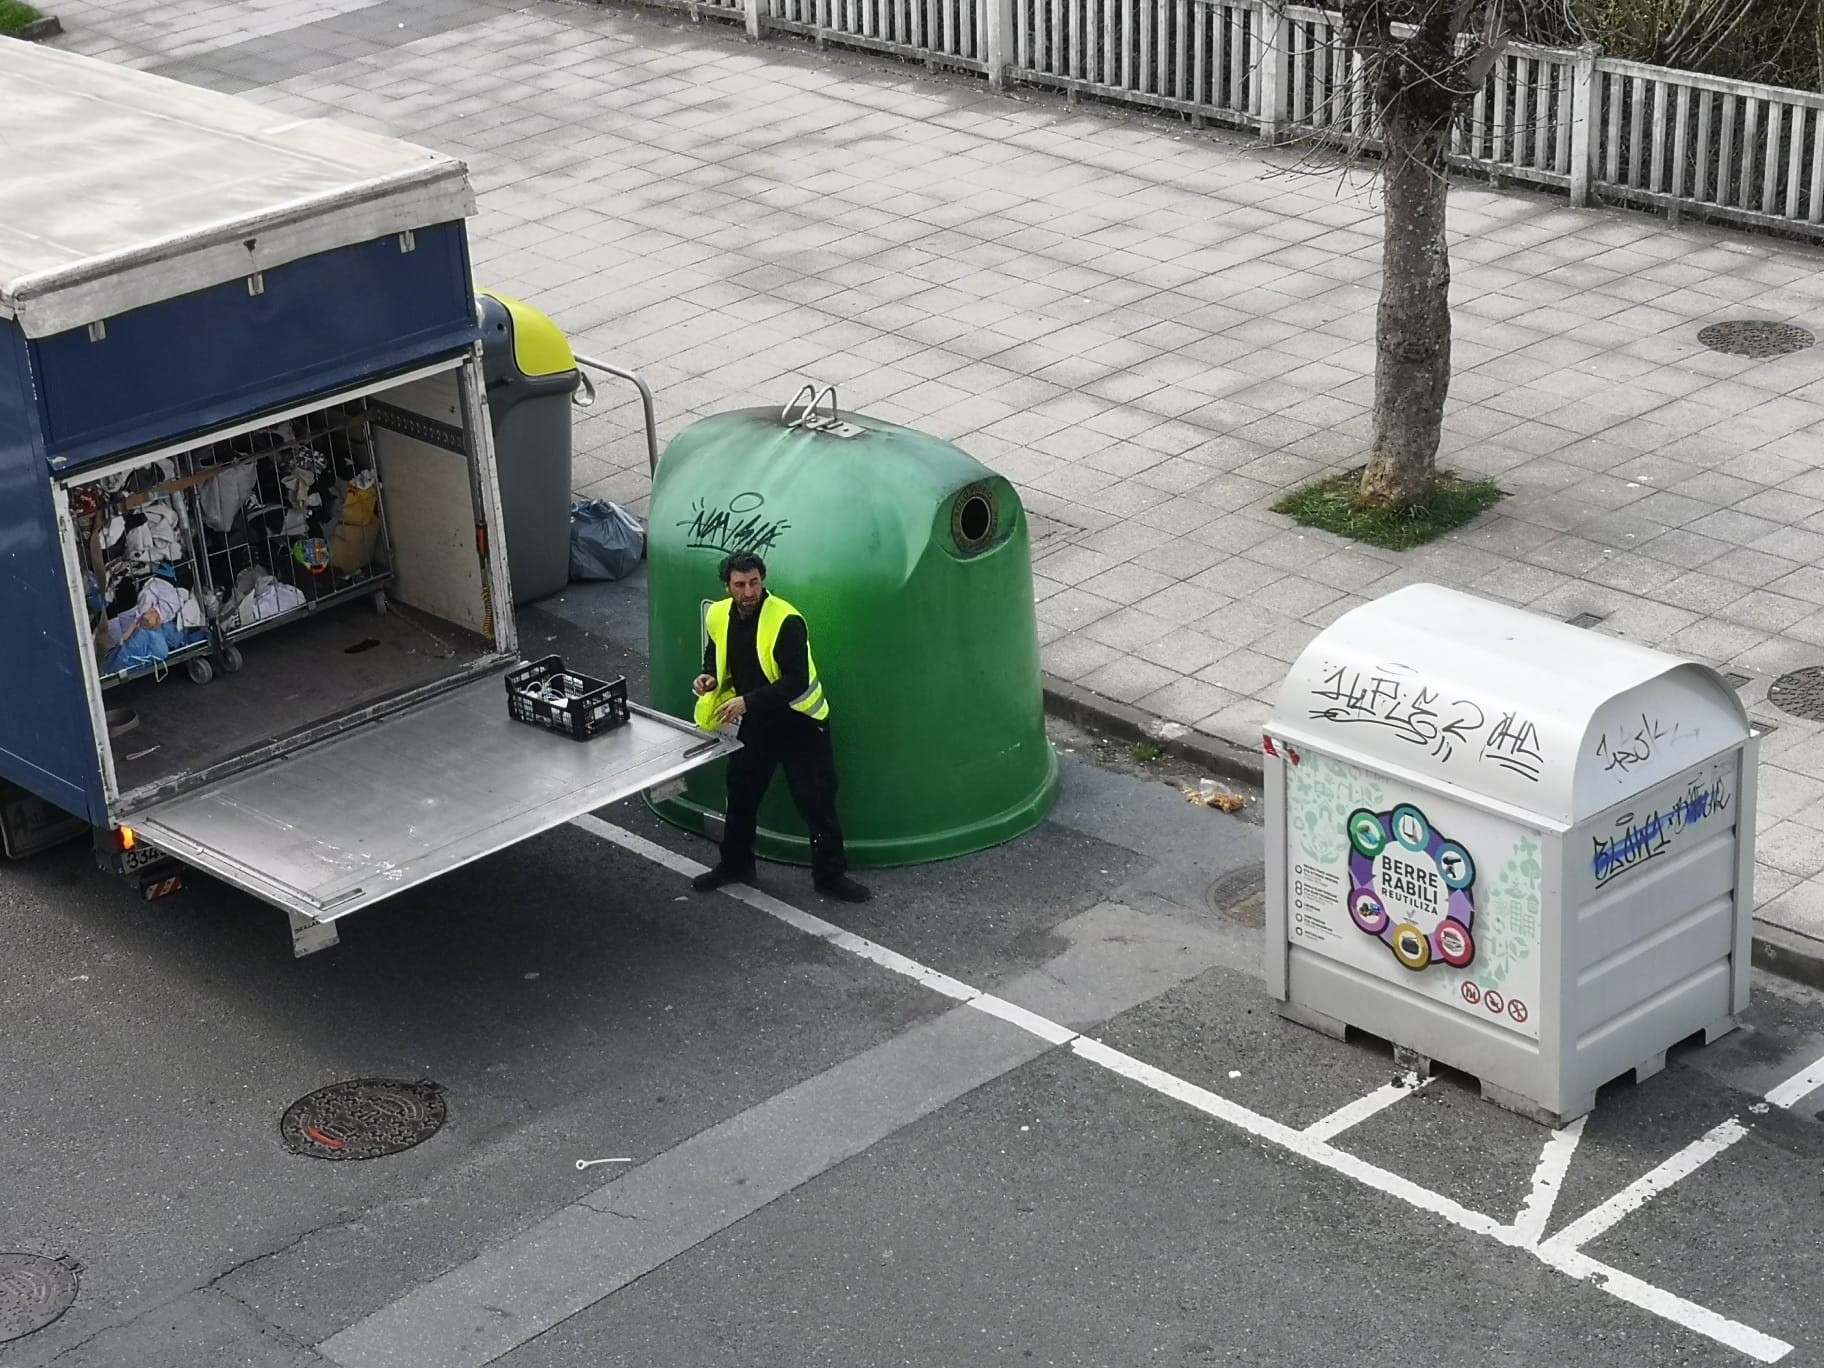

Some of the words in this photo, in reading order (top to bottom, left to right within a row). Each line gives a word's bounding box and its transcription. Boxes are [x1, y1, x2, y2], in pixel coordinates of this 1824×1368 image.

[1381, 855, 1438, 889] BERRE
[1381, 871, 1438, 905] RABILI
[1381, 886, 1439, 916] REUTILIZA
